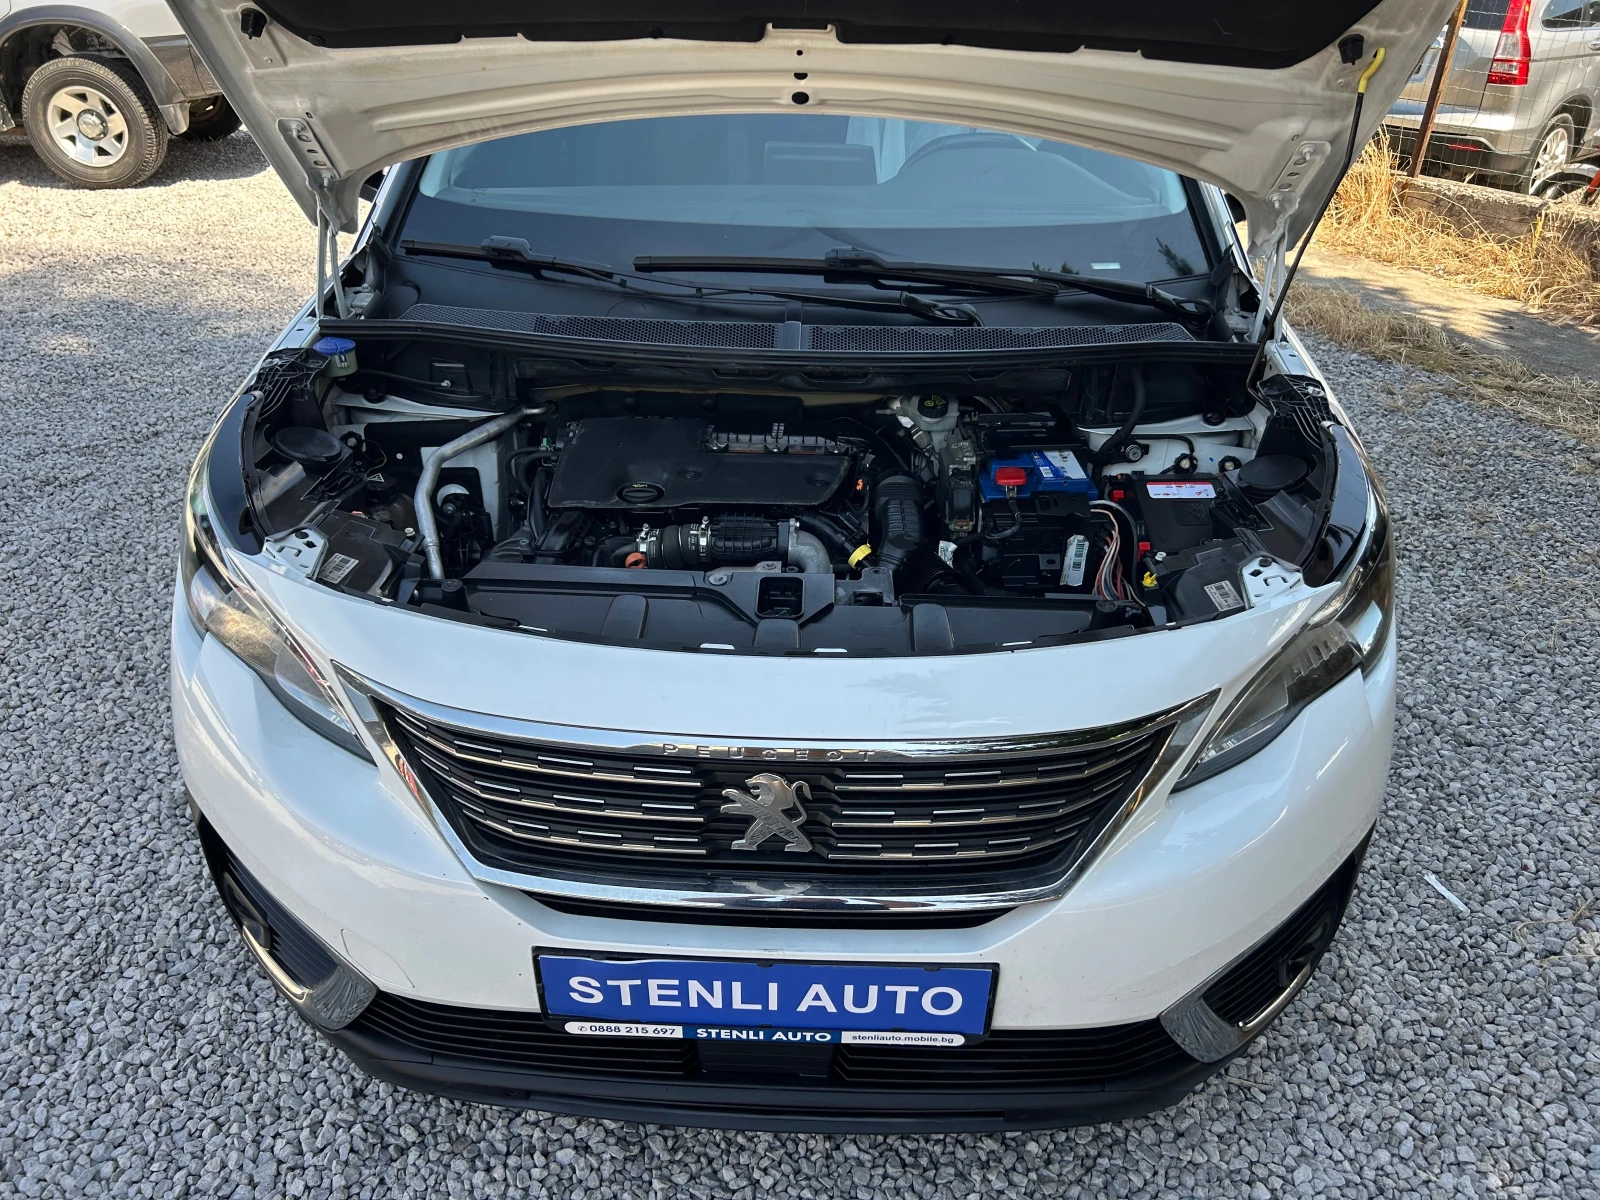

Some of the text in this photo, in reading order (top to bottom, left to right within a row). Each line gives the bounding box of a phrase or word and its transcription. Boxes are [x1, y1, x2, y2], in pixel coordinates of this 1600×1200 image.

[662, 743, 875, 762] PEUGEOT
[568, 975, 963, 1016] STENLI AUTO
[589, 1025, 676, 1036] 0888 215 697
[696, 1028, 832, 1042] STENLI AUTO
[851, 1034, 954, 1044] stenliauto.mobile.bg
